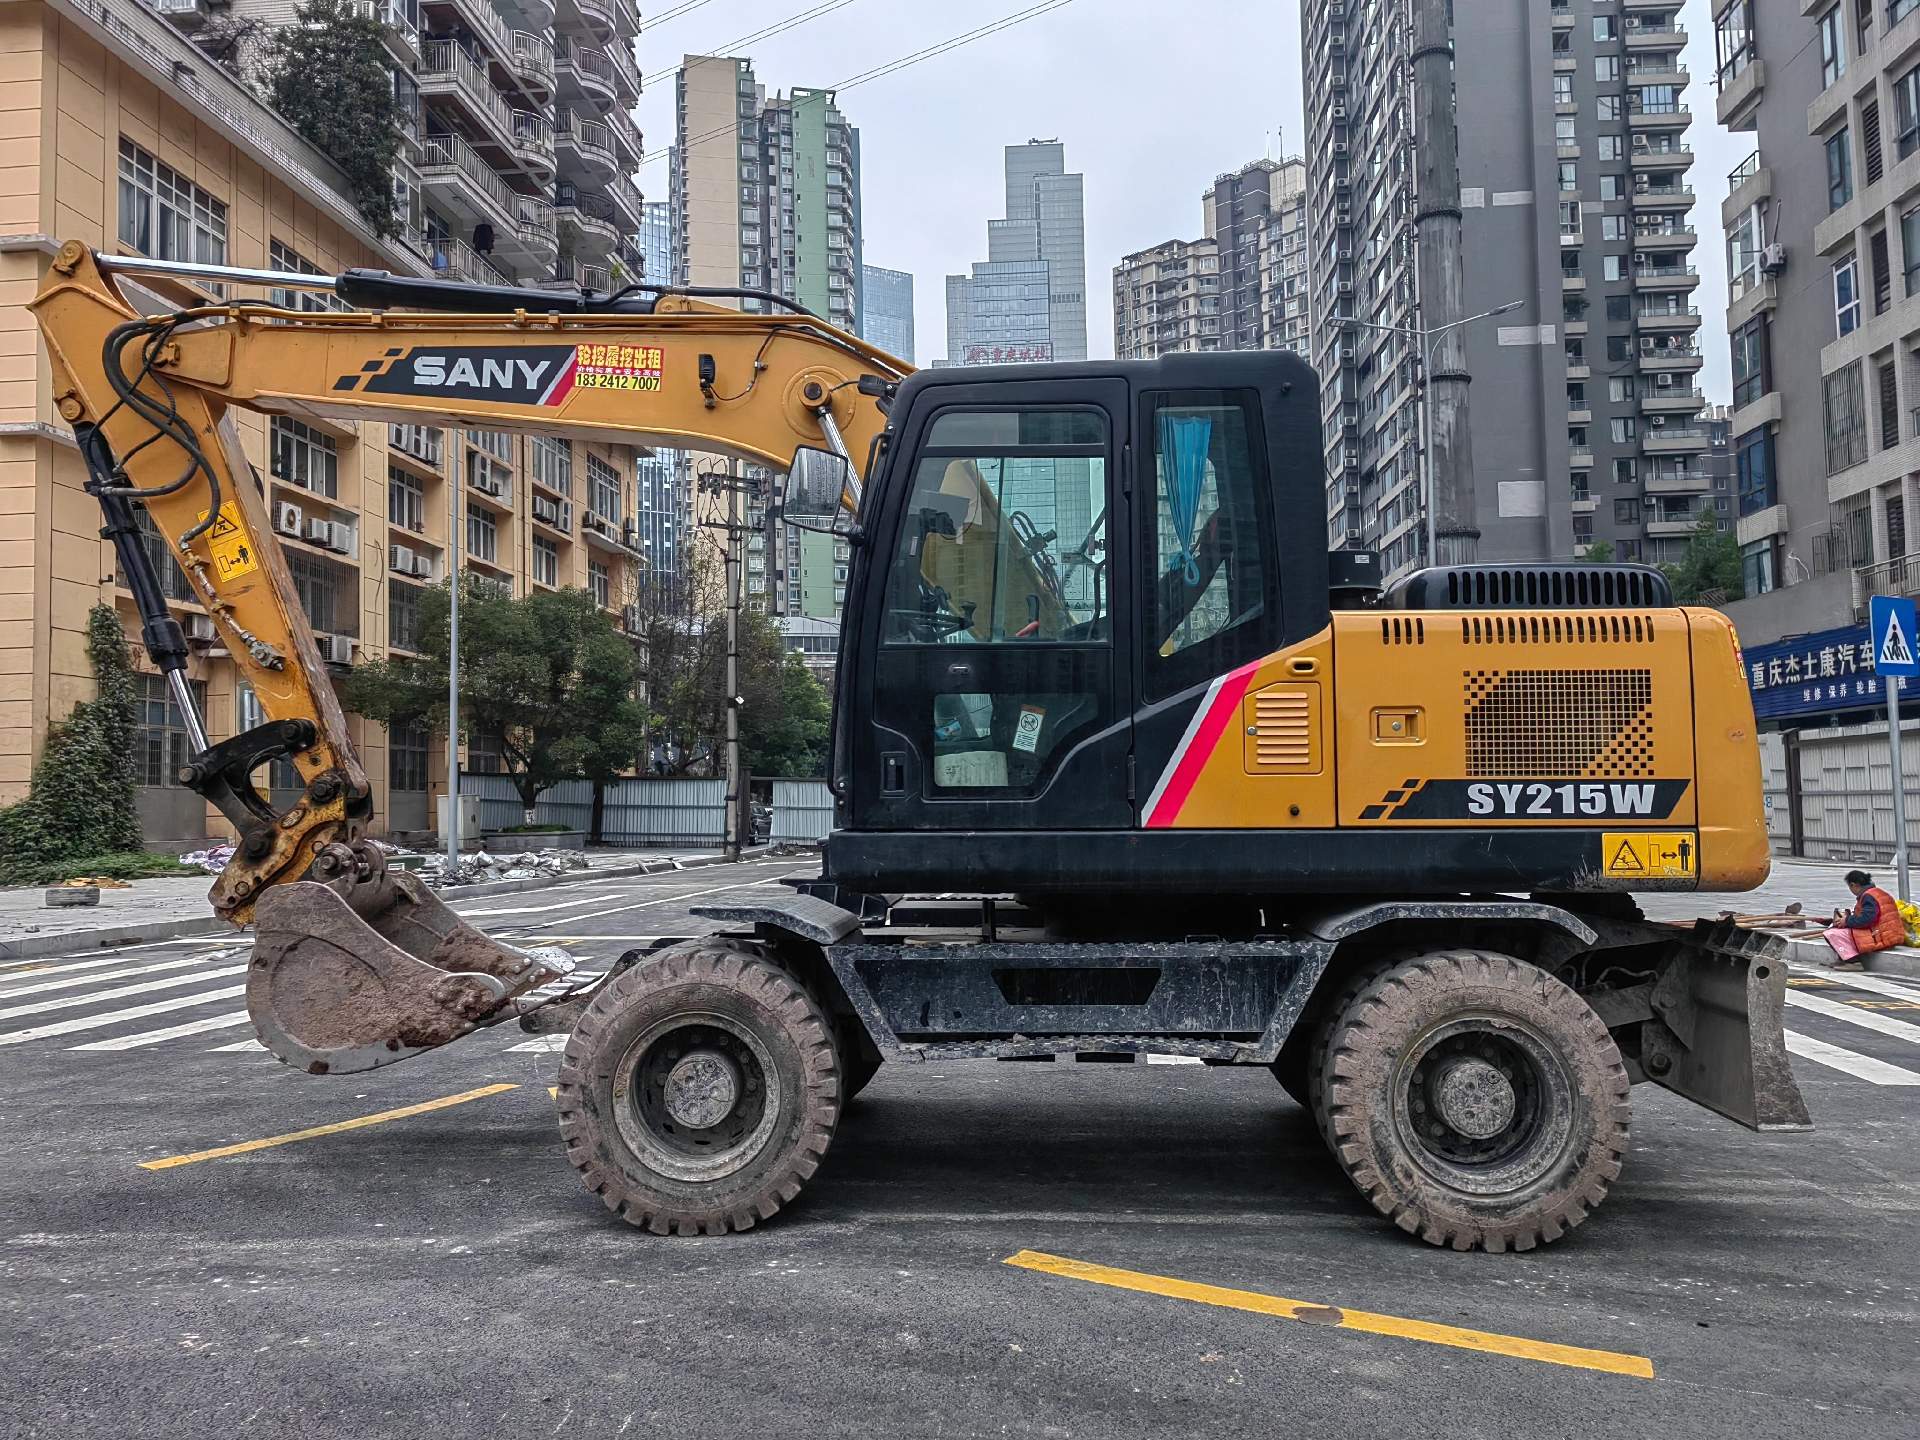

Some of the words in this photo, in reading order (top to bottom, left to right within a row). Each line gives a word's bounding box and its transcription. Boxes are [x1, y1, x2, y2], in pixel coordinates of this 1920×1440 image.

[578, 344, 661, 368] 轮挖履挖出租
[413, 356, 551, 390] SANY
[577, 374, 596, 386] 183
[600, 374, 628, 388] 2412
[632, 377, 659, 390] 7007
[1467, 783, 1656, 814] SY215W
